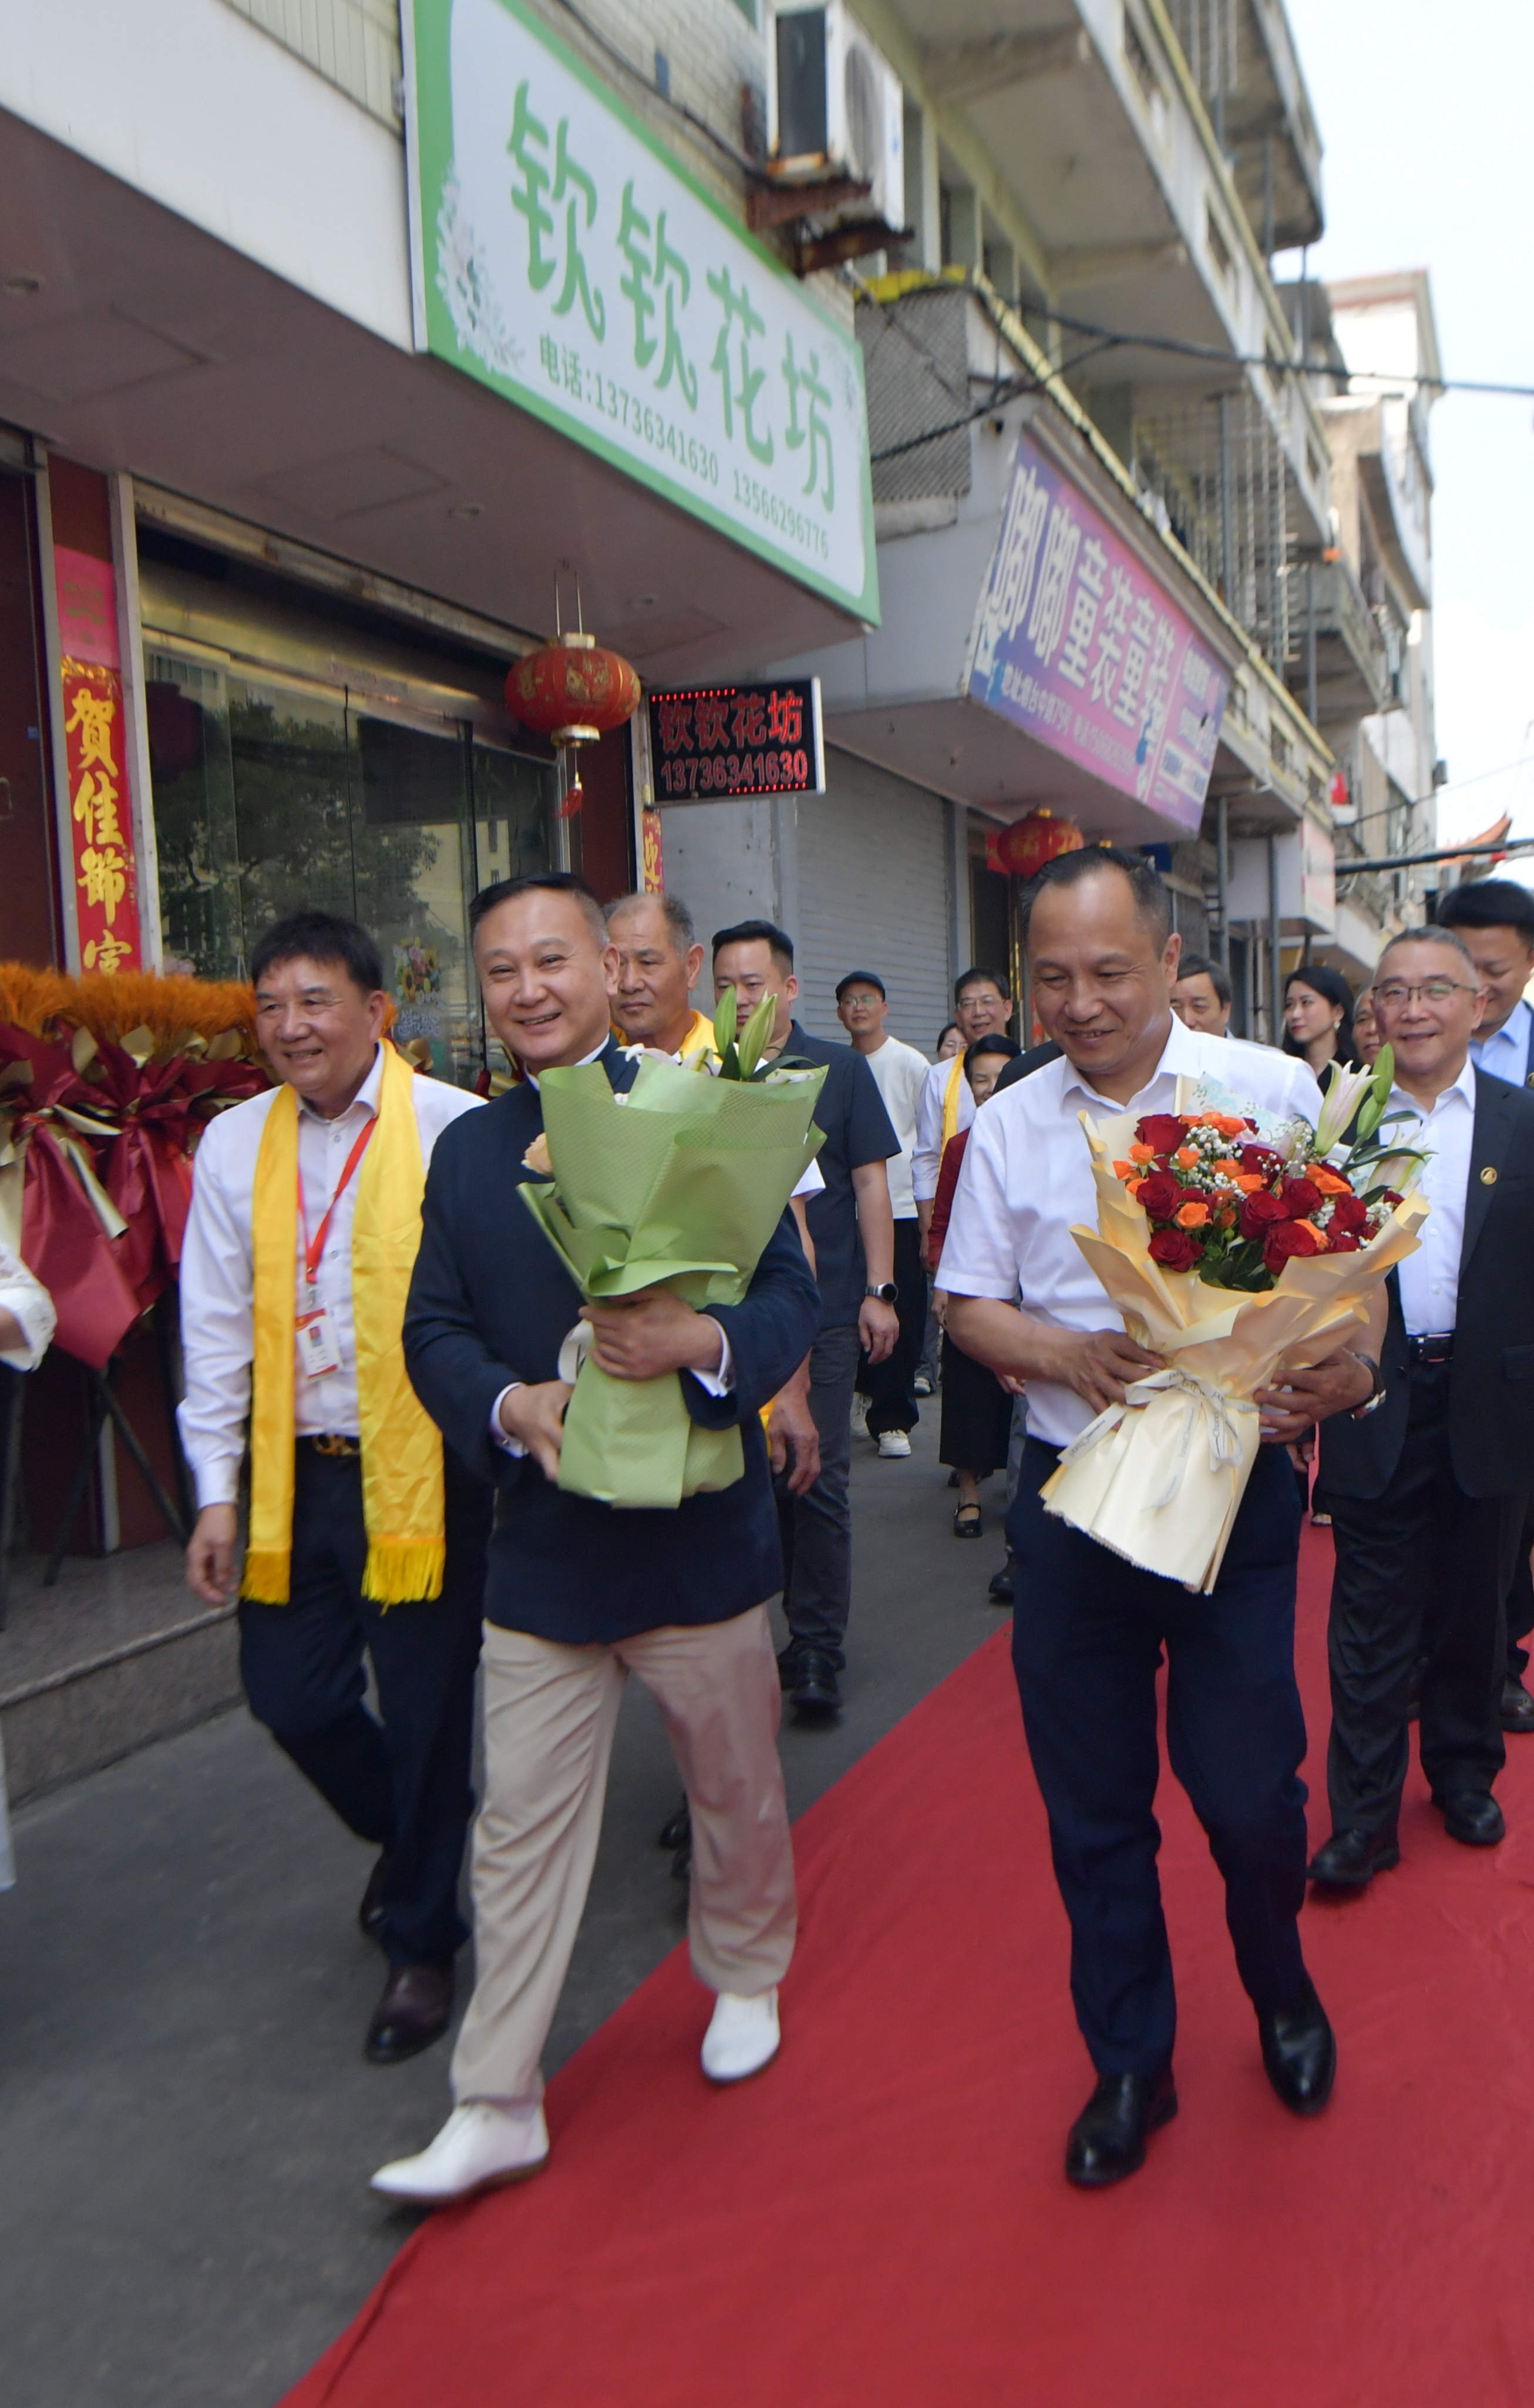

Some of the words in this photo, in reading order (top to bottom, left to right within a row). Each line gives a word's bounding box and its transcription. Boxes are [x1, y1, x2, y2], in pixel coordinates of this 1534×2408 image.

[507, 79, 833, 513] 钦钦花坊
[733, 475, 829, 559] 13566296776
[658, 689, 803, 752] 钦钦花坊
[661, 749, 808, 792] 13736341630
